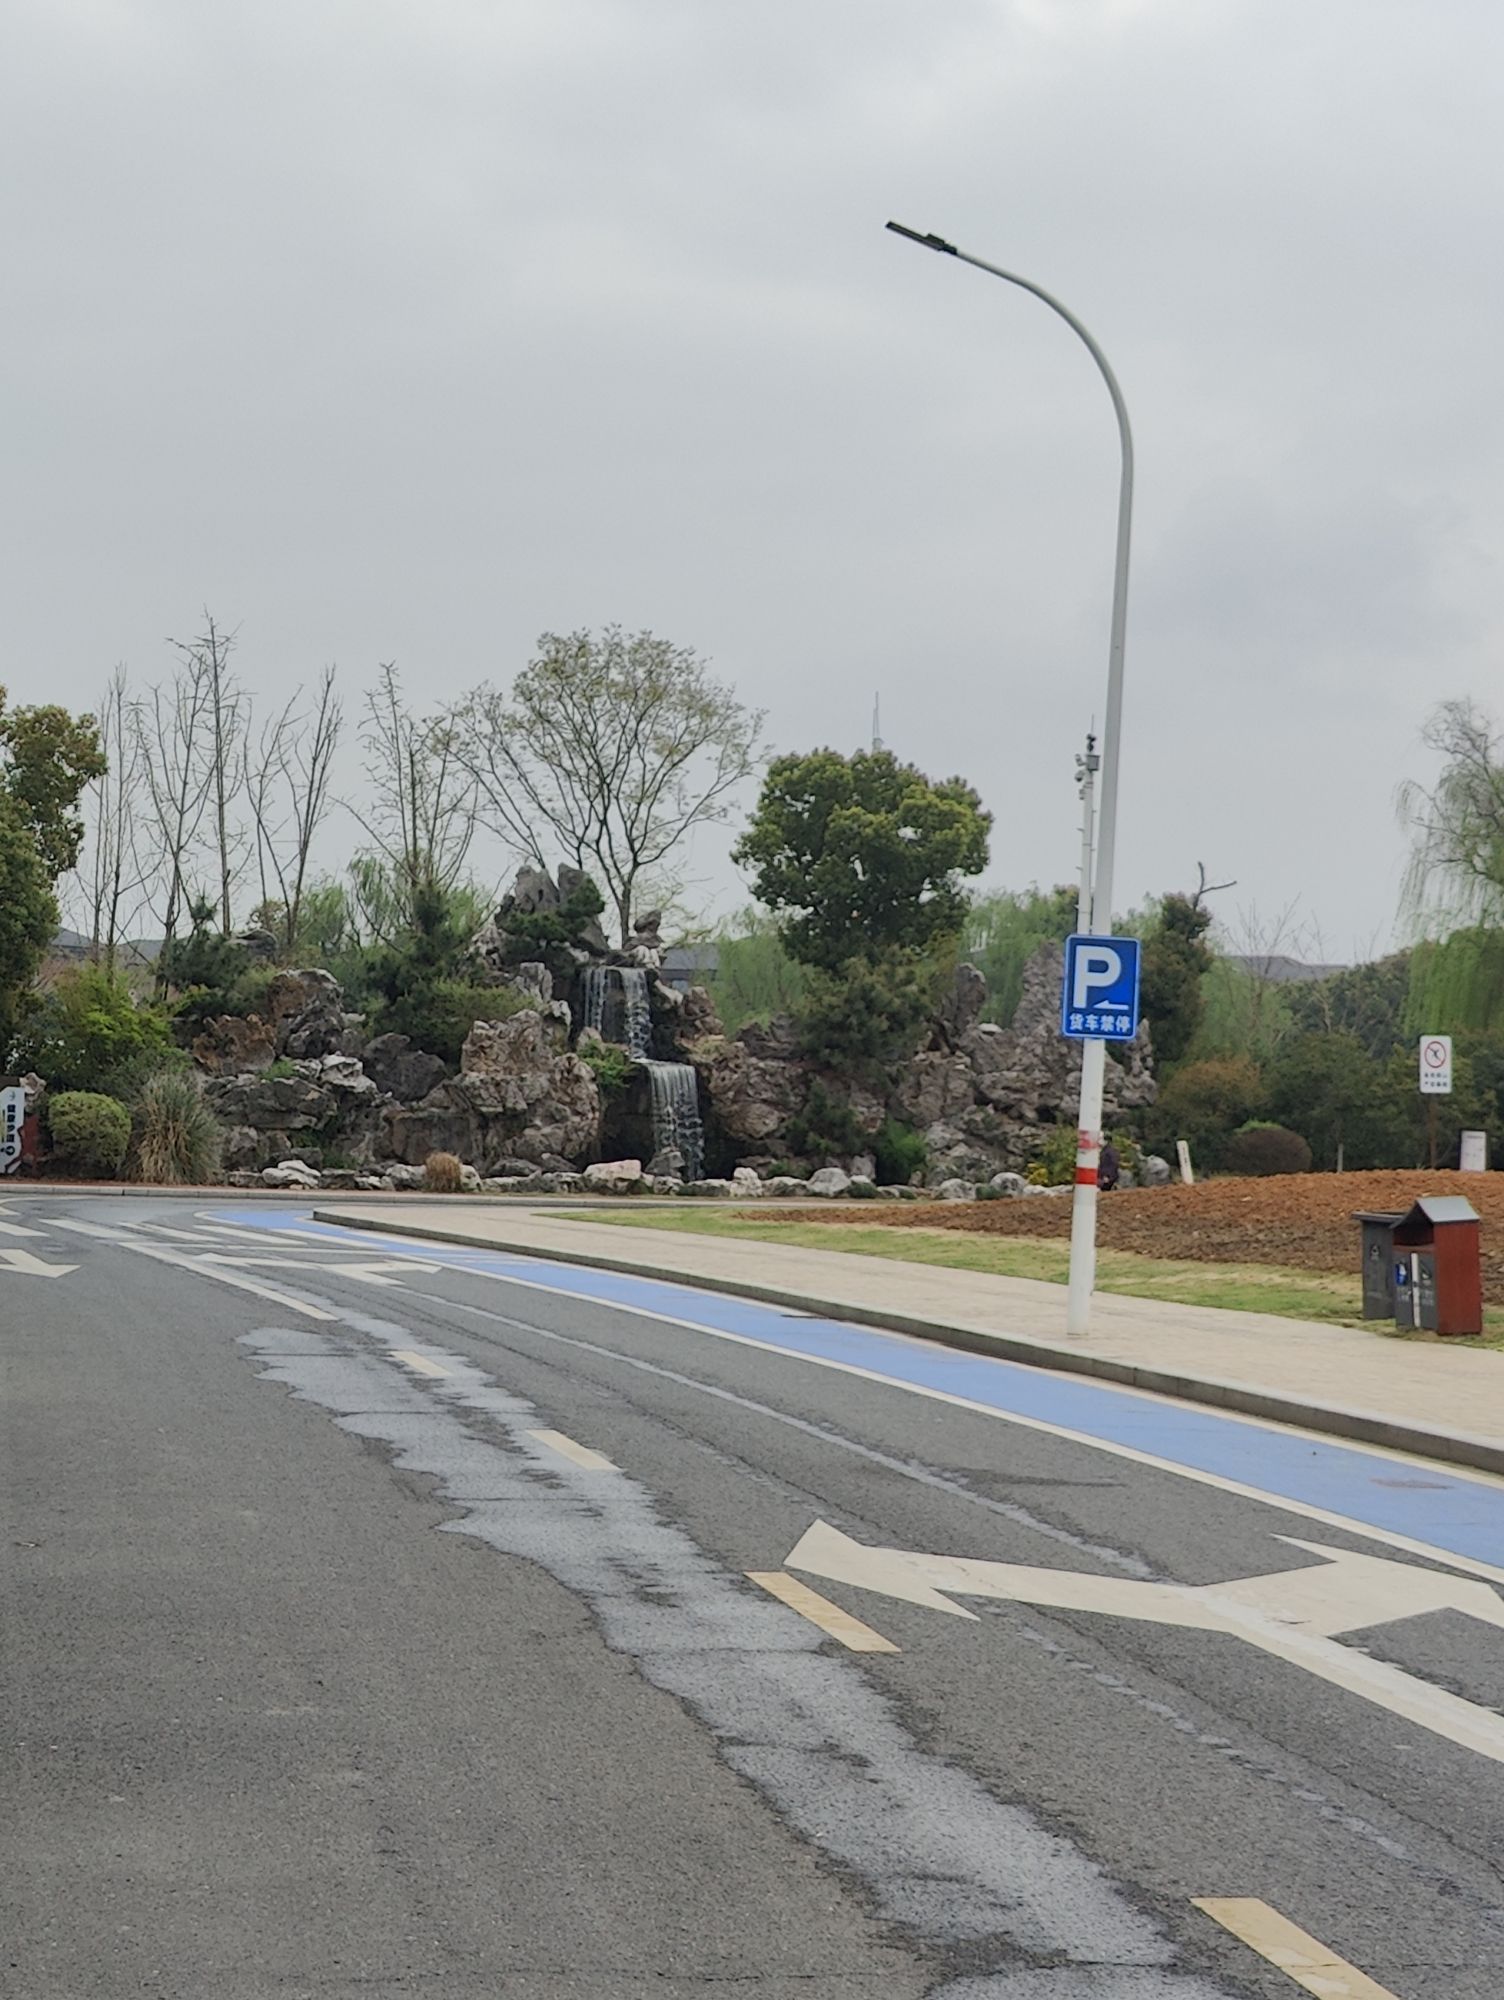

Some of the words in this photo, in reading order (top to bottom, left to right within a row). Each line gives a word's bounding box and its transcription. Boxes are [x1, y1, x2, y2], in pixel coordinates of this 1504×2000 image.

[1073, 945, 1121, 1008] P
[1069, 1013, 1130, 1032] 货车禁停
